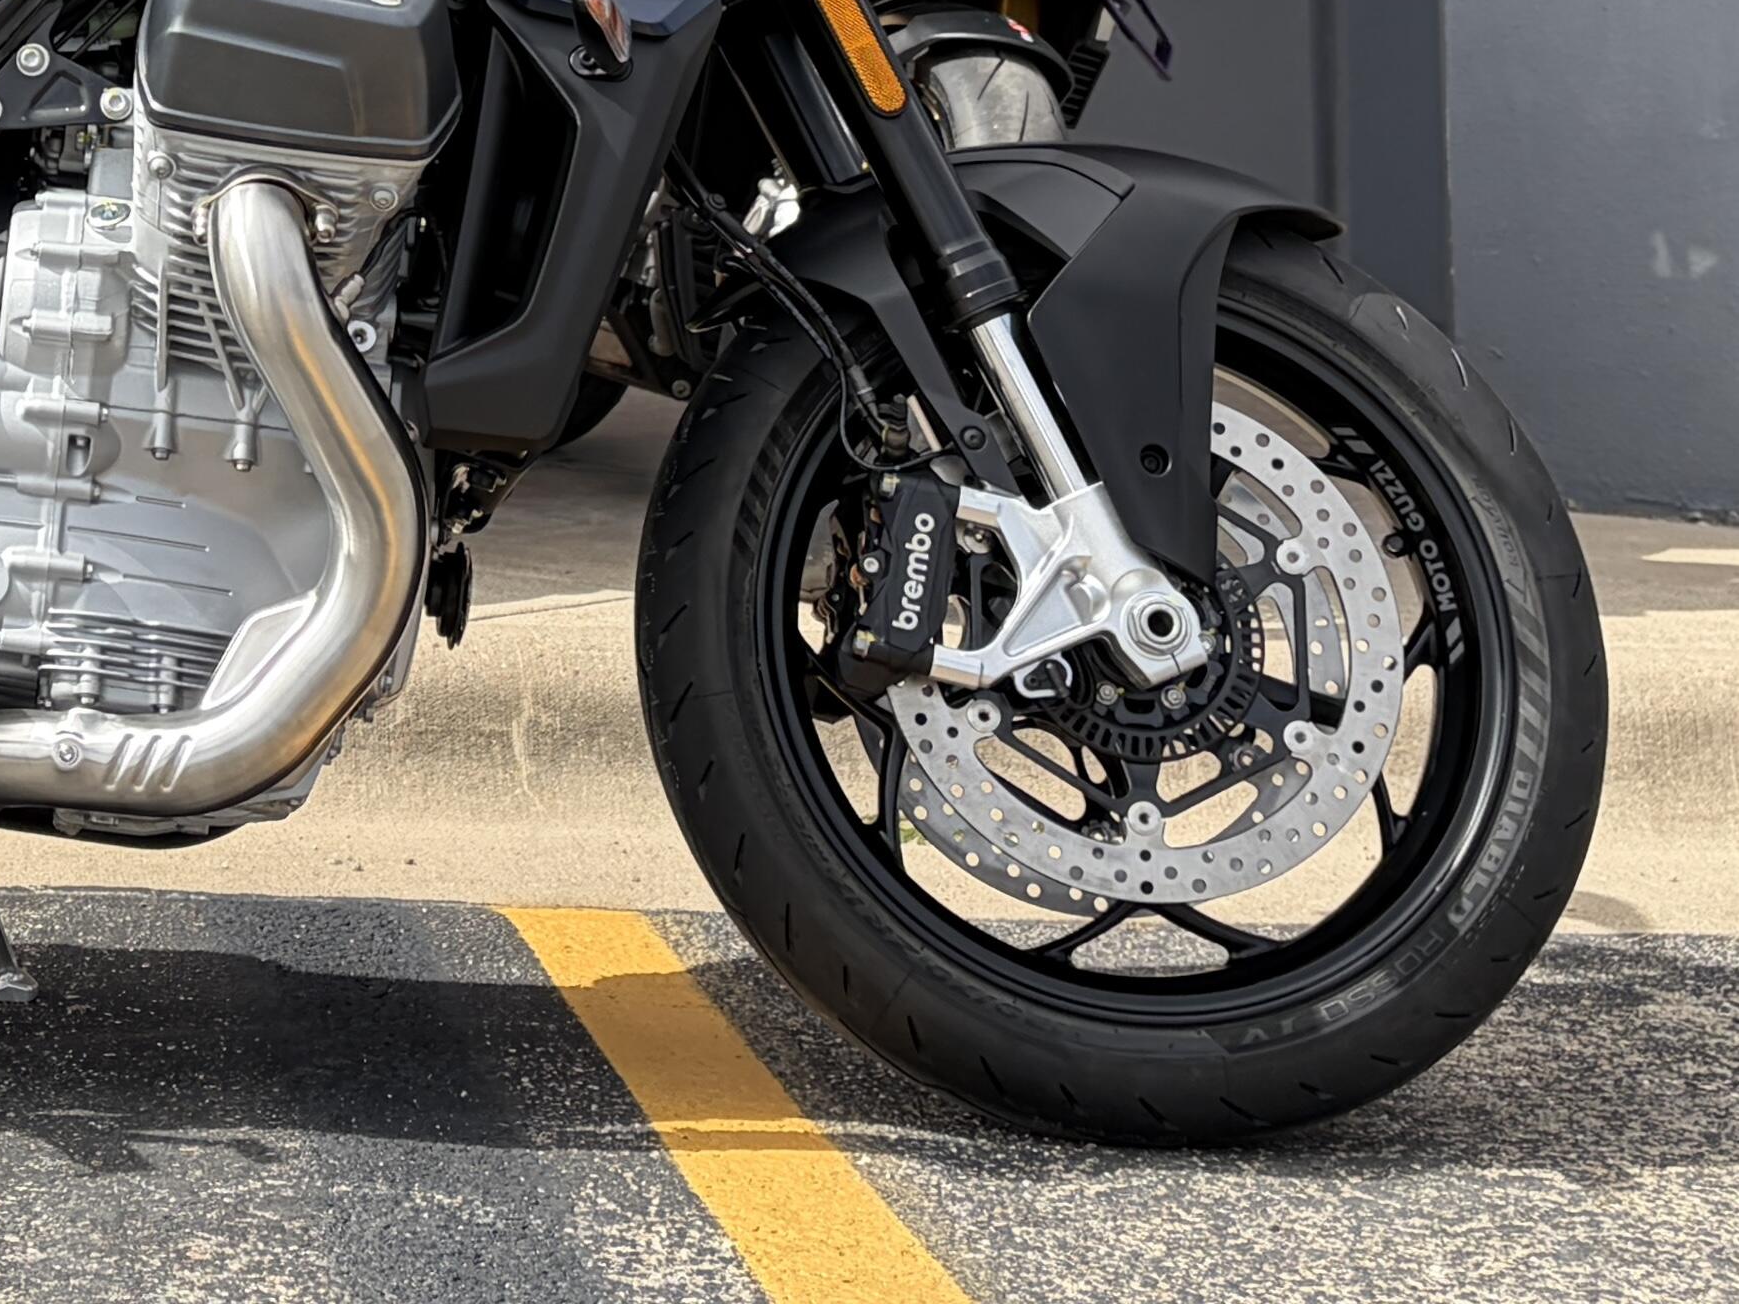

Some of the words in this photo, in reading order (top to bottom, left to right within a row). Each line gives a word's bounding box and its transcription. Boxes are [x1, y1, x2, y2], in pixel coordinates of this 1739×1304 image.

[1369, 459, 1426, 533] GUZZI
[891, 512, 935, 631] brembo
[1418, 538, 1458, 613] MOTO
[1447, 769, 1535, 926] DIABLO
[1319, 929, 1446, 1022] ROSSO
